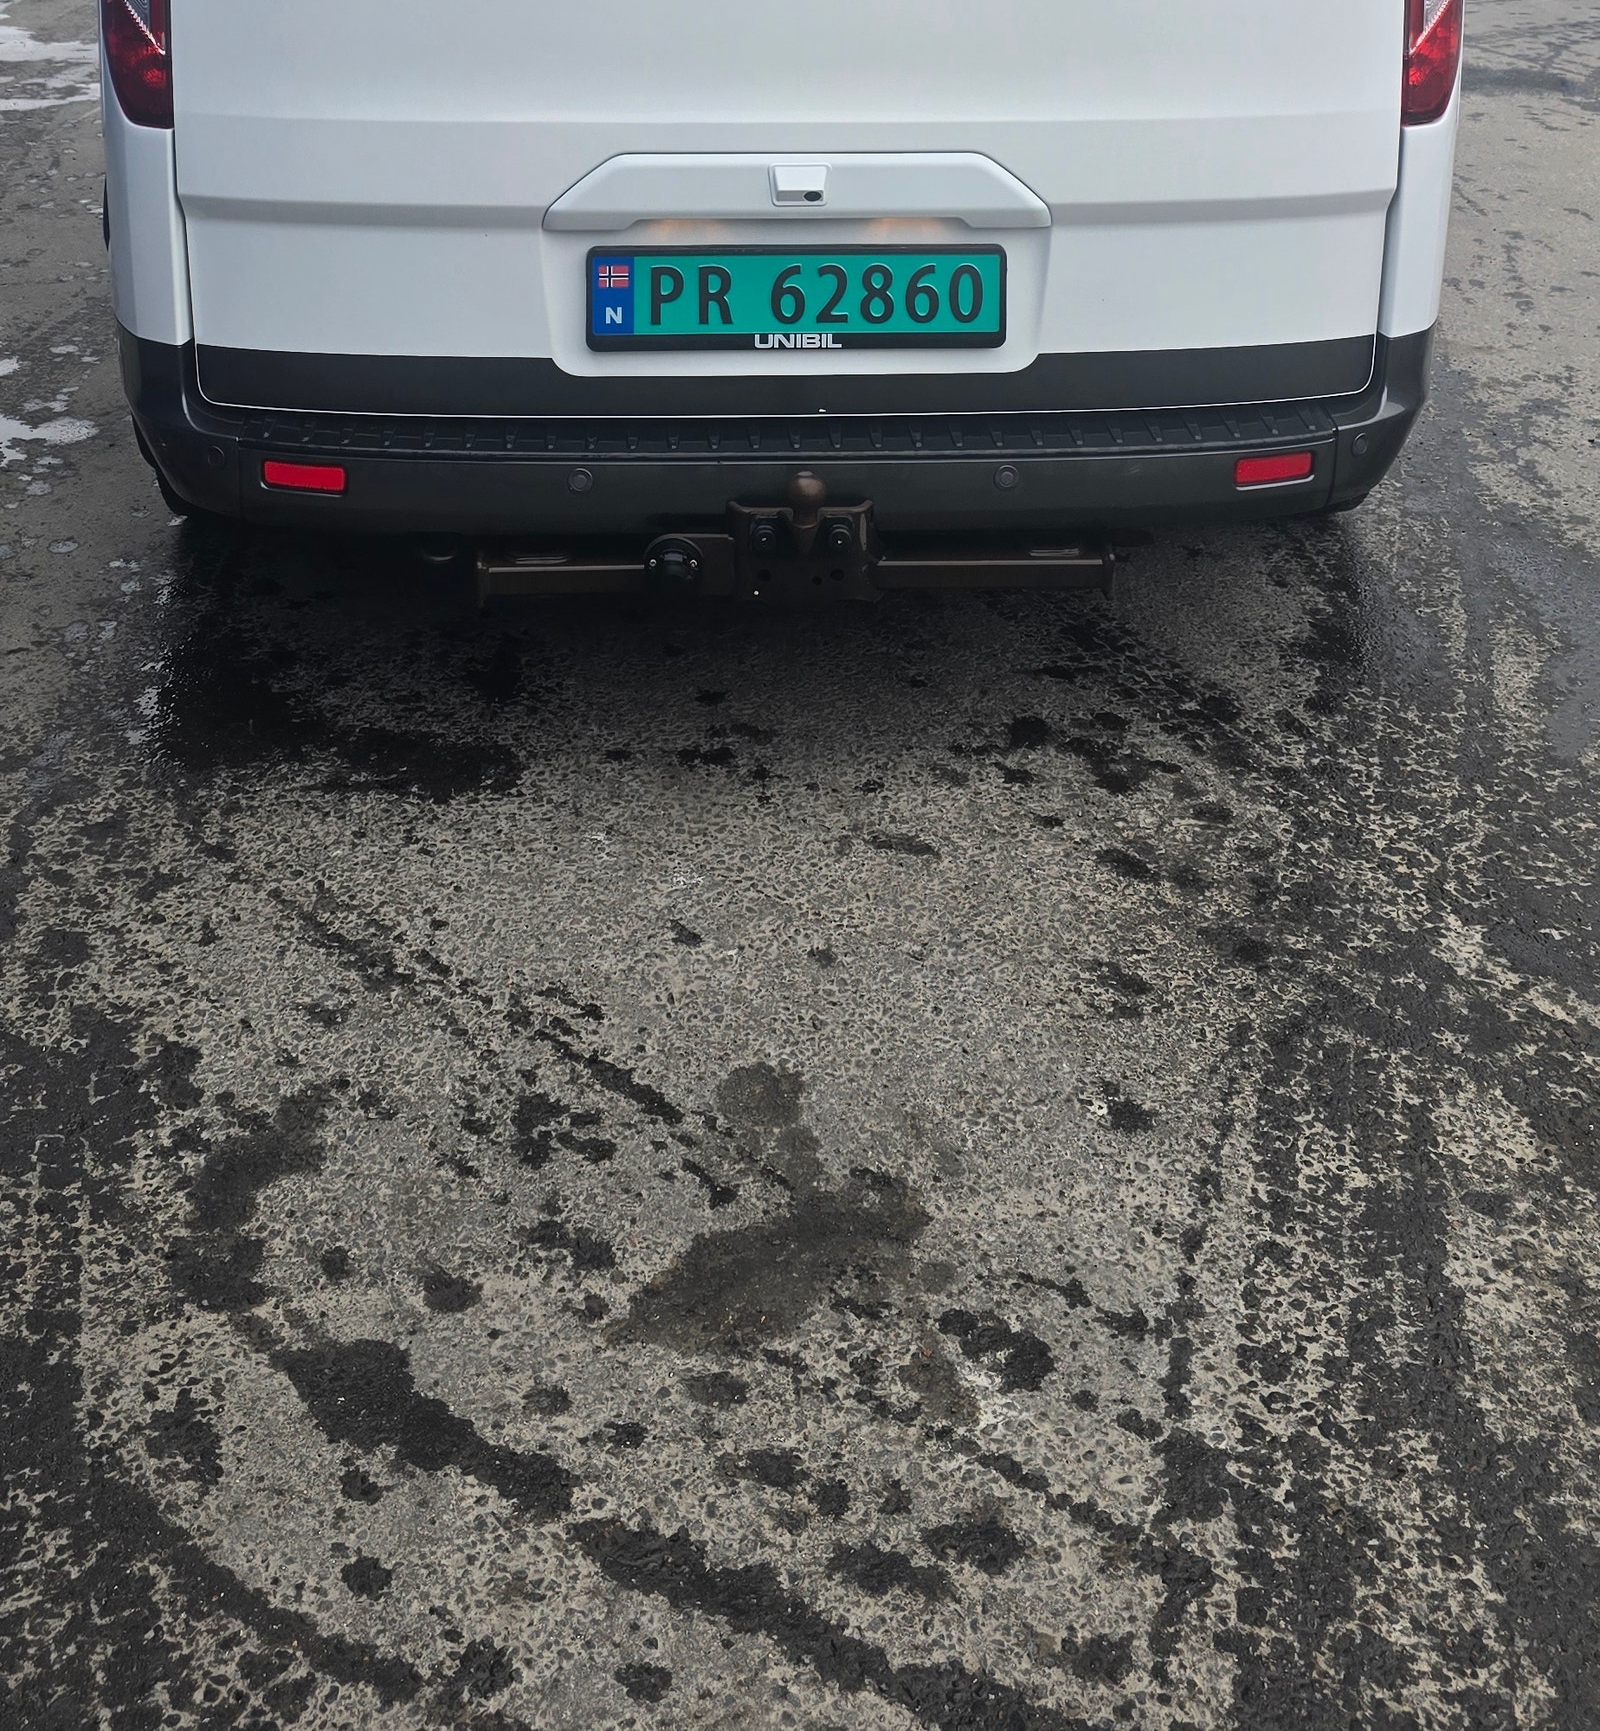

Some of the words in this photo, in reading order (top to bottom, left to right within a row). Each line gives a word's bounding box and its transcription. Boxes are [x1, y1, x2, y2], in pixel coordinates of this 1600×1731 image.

[650, 266, 733, 325] PR
[770, 263, 984, 324] 62860
[605, 307, 622, 324] N
[754, 333, 842, 349] UNIBIL
